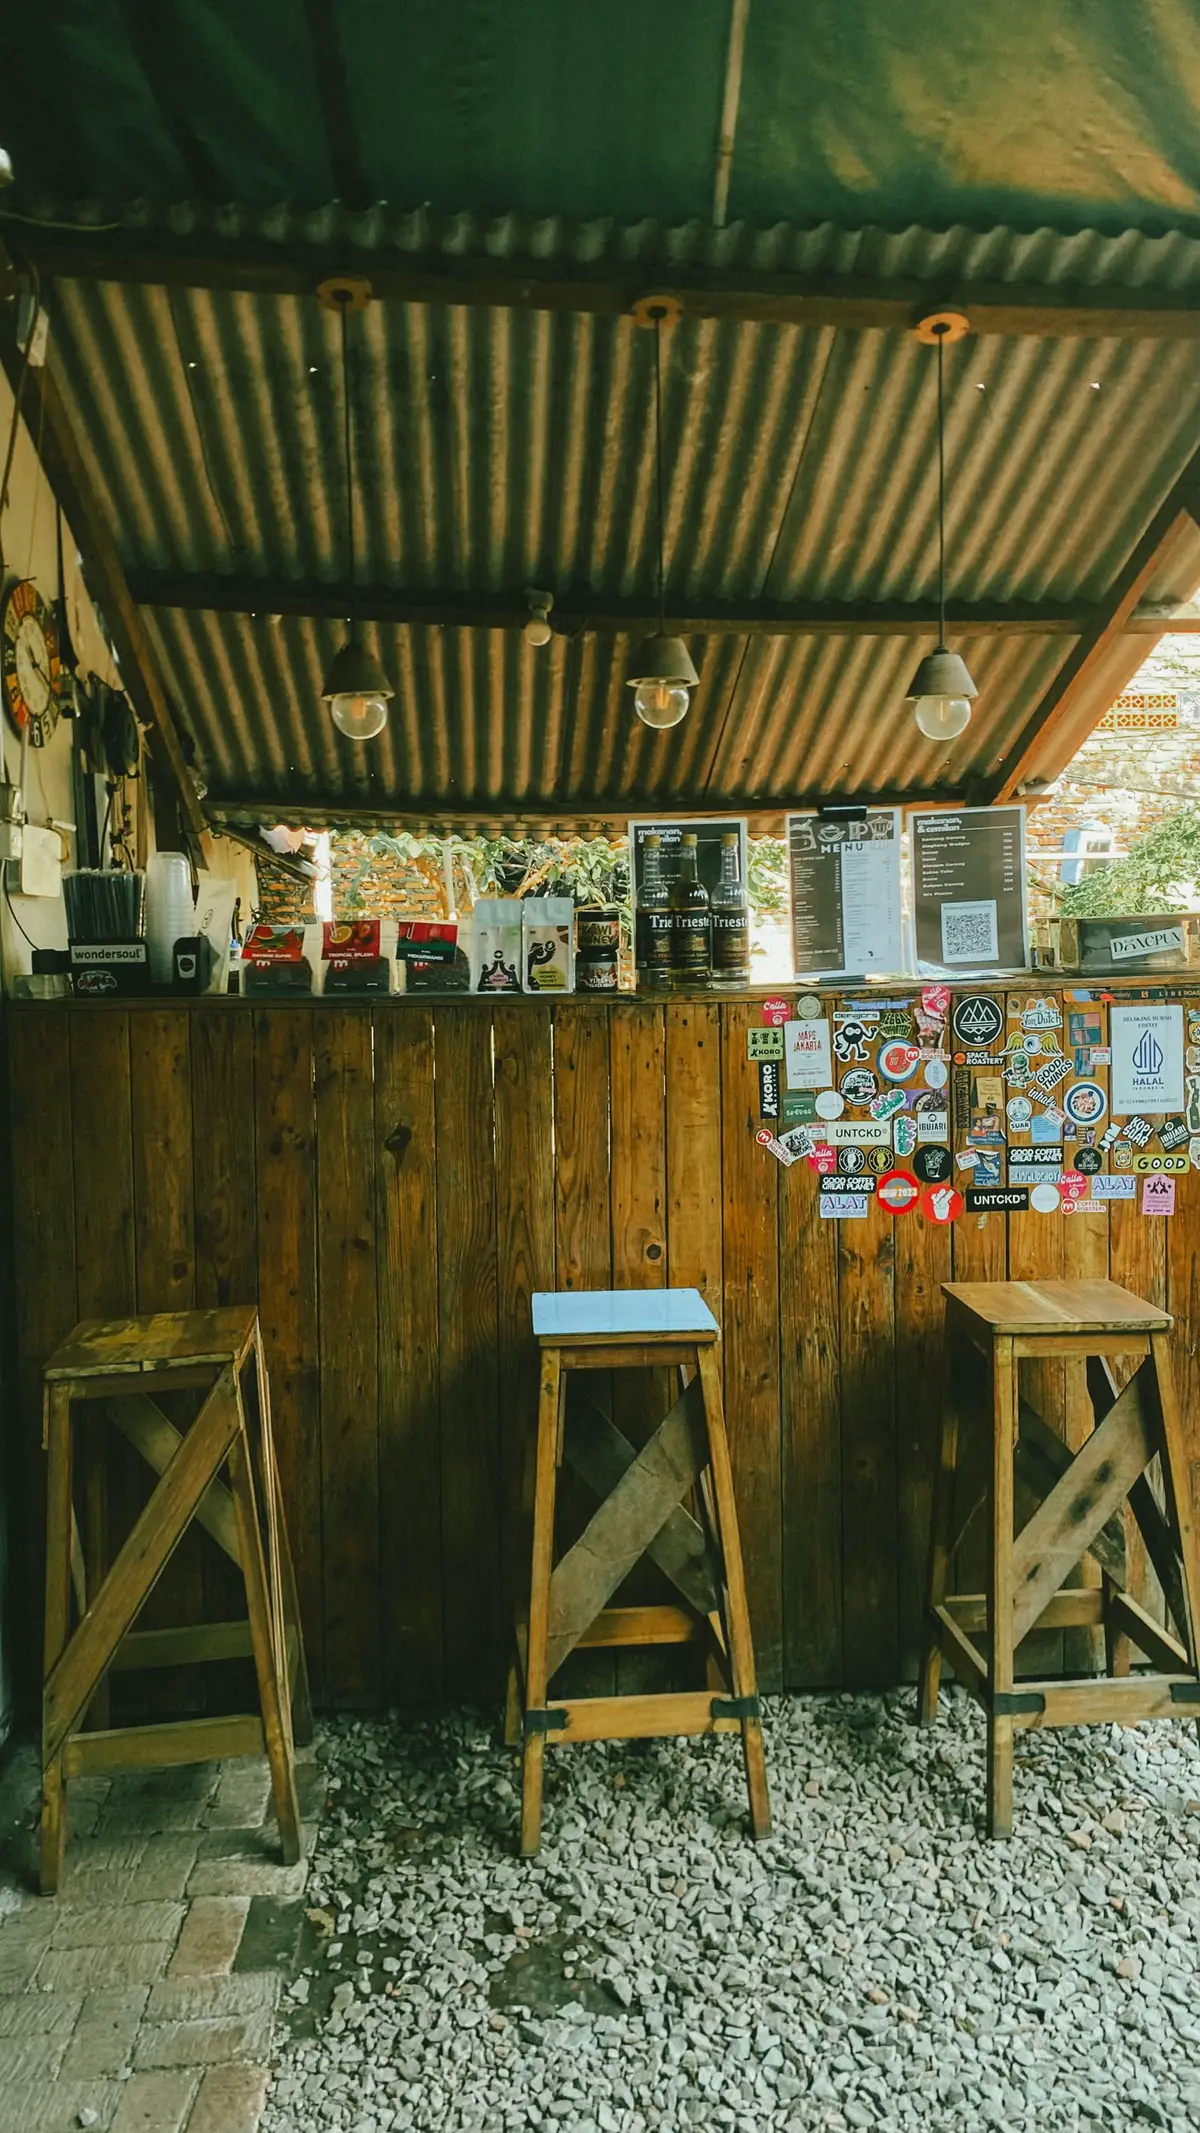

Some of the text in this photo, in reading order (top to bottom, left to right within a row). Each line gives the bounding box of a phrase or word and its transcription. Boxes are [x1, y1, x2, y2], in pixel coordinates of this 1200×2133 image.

[32, 722, 40, 746] 6
[820, 842, 864, 853] MENU
[74, 948, 141, 959] wondersoul
[763, 1001, 788, 1011] Calla
[1037, 1012, 1062, 1025] Dutch
[798, 1030, 816, 1040] MAPS
[793, 1040, 822, 1052] JAKARTA
[1037, 1058, 1061, 1084] GOOD
[1043, 1060, 1073, 1090] THINGS
[763, 1064, 773, 1102] KORO
[1133, 1077, 1164, 1086] HALAL
[1028, 1086, 1056, 1107] inhale
[1130, 1116, 1154, 1136] KOPI
[1122, 1125, 1148, 1148] SUAR
[1011, 1148, 1034, 1156] GOOD
[1138, 1158, 1186, 1170] GOOD
[1061, 1174, 1083, 1184] Calla
[1092, 1176, 1136, 1190] ALAT
[822, 1196, 867, 1209] ALAT
